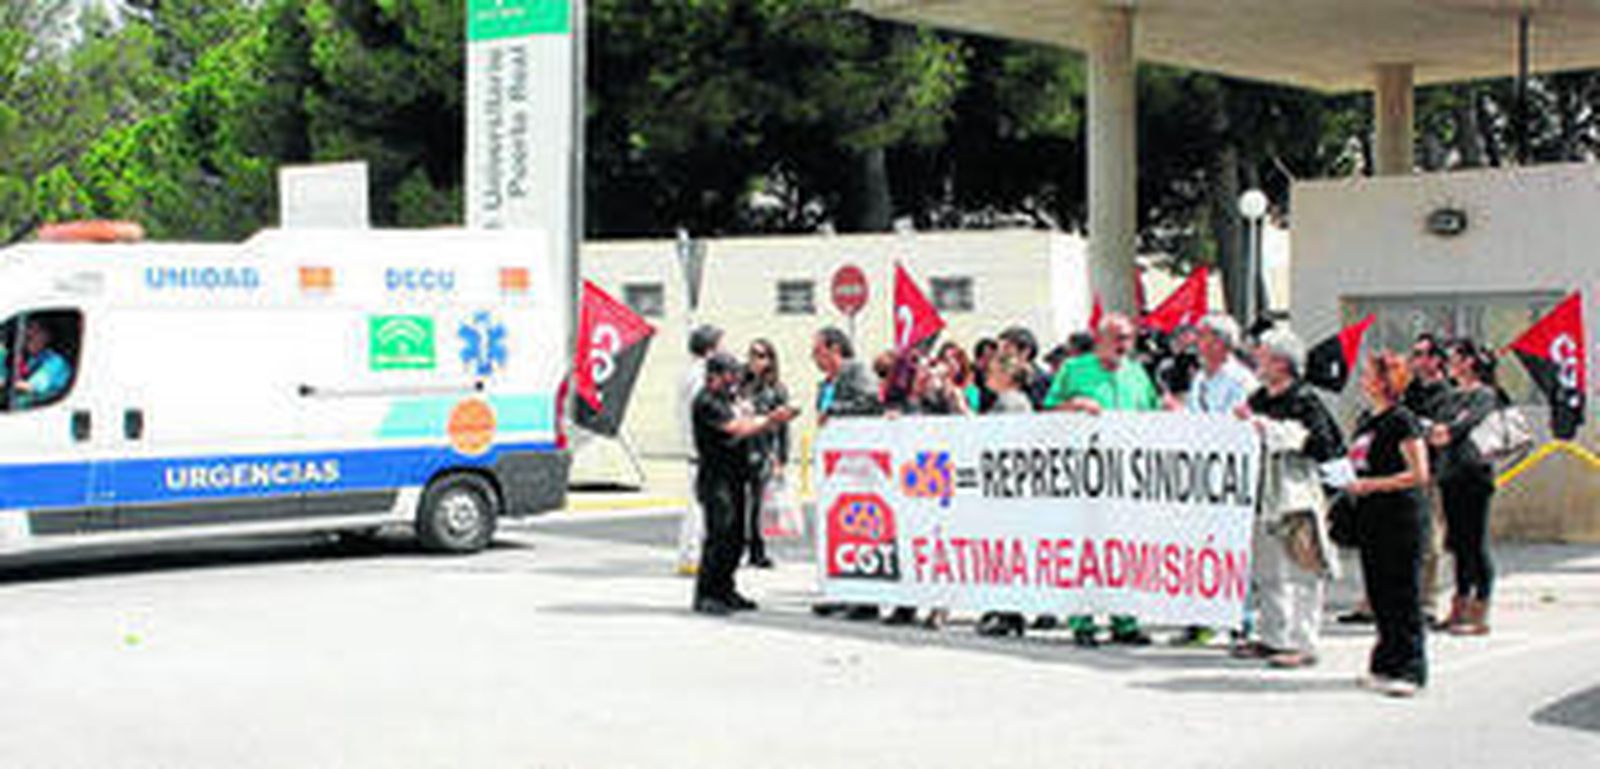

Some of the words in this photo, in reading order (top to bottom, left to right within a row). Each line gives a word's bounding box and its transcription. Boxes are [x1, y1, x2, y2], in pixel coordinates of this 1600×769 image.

[145, 267, 259, 290] UNIDAD
[165, 460, 340, 490] URGENCIAS
[1131, 448, 1252, 506] SINDICAL
[836, 543, 898, 575] CGT
[1035, 534, 1248, 602] READMISIÓN
